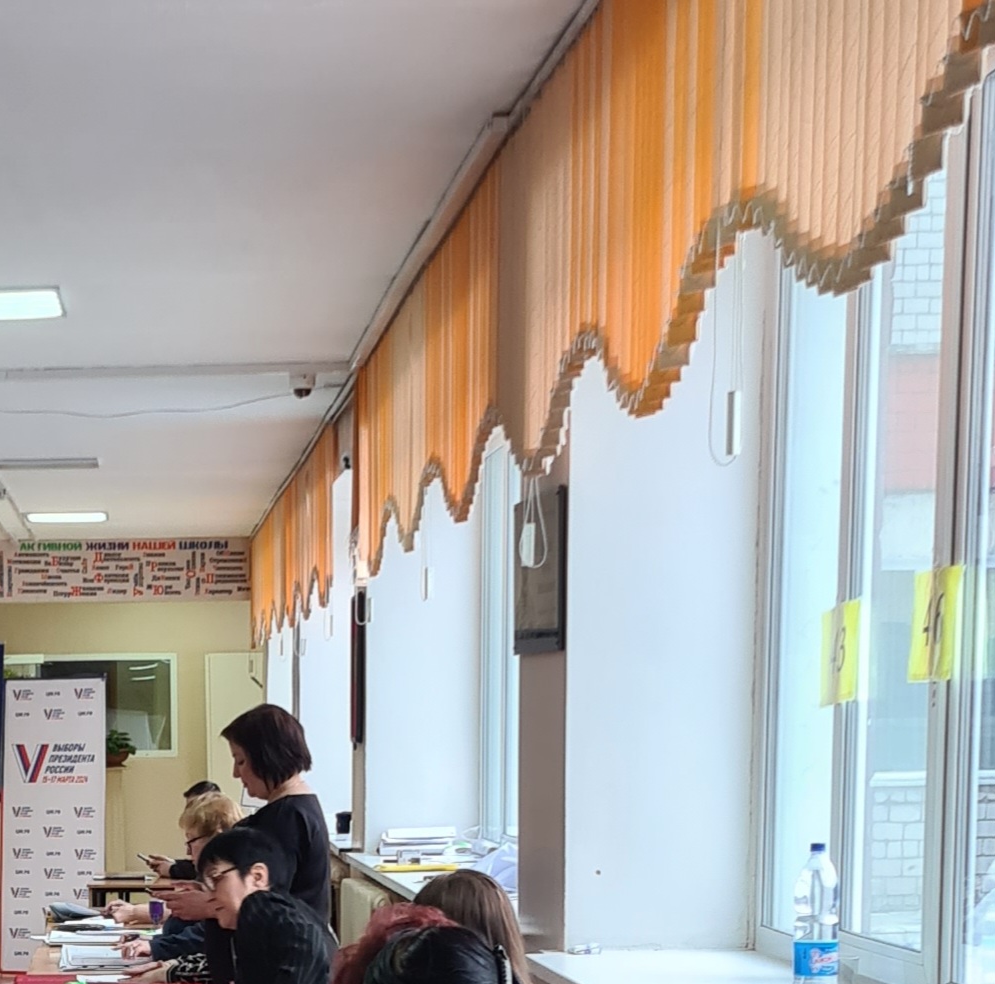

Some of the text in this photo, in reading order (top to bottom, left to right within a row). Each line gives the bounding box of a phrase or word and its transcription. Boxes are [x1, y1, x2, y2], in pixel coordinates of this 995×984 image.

[86, 541, 129, 551] ЖИЗНИ
[132, 540, 176, 550] НАШЕЙ
[179, 540, 228, 550] ШКОЛЫ
[52, 743, 86, 752] ВЫБОРЫ
[48, 754, 95, 763] ПРЕЗИДЕНТА
[44, 765, 75, 774] РОССИИ
